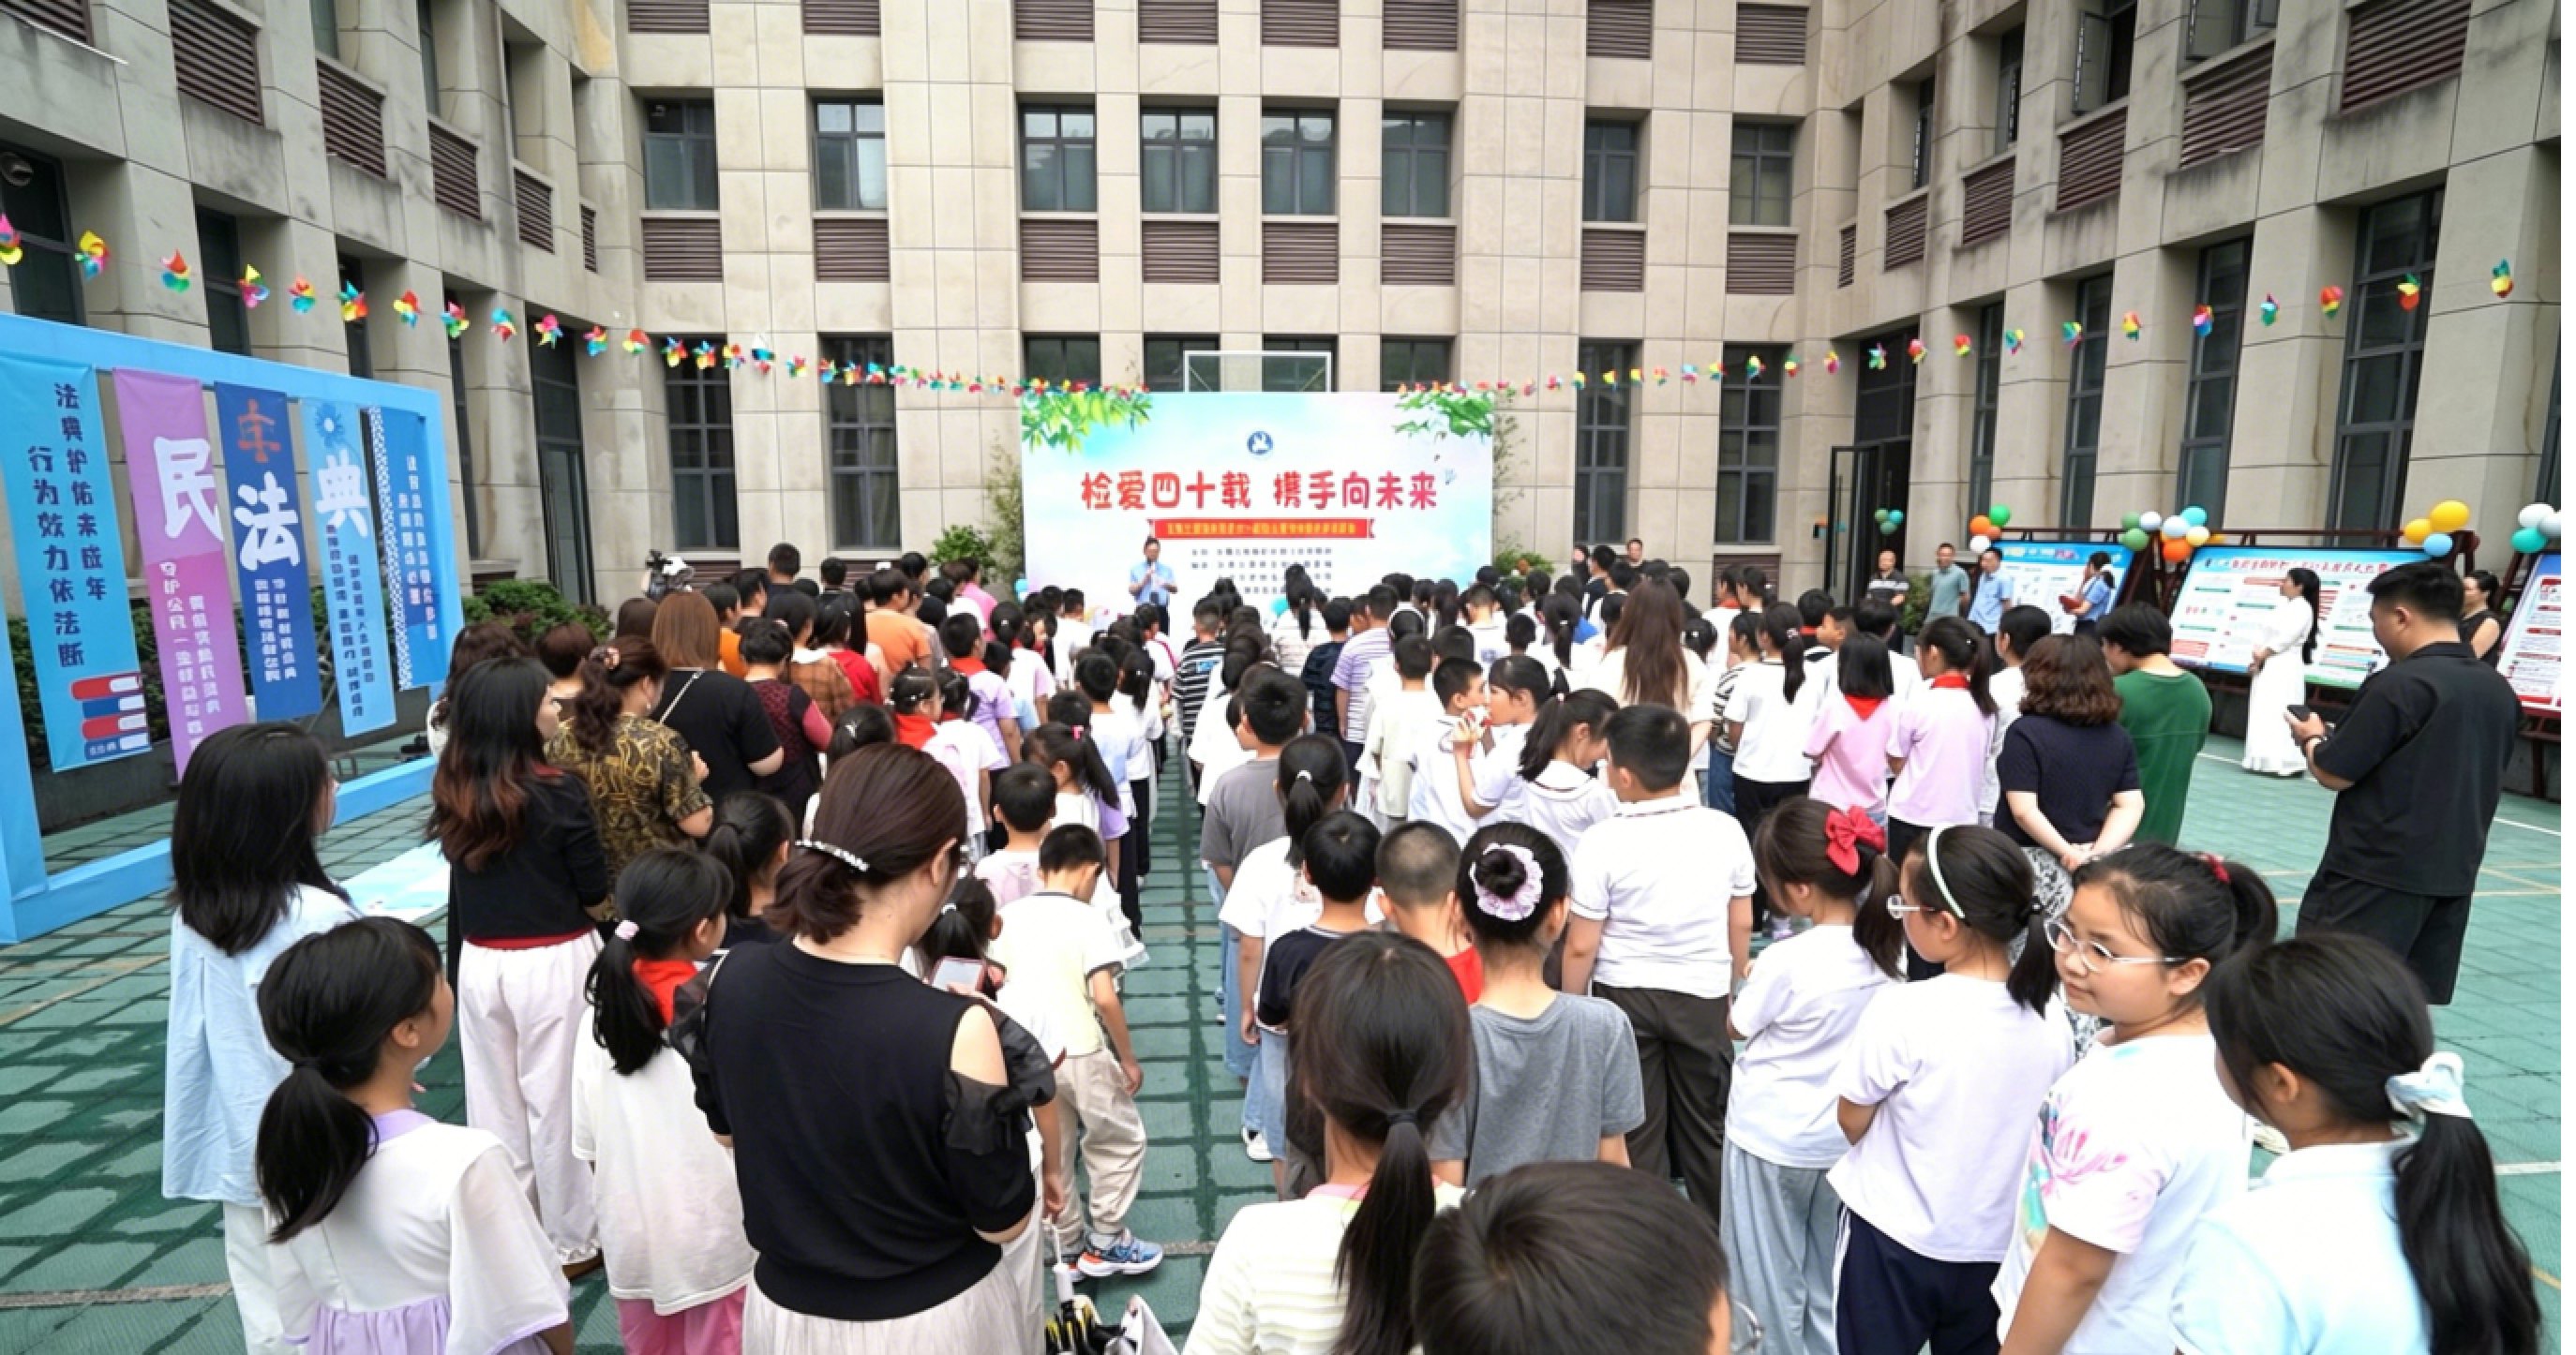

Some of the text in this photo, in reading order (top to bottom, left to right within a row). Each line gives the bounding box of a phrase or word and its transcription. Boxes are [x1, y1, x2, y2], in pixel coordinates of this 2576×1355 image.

[153, 437, 225, 542] 民
[233, 470, 299, 572] 法
[316, 452, 369, 538] 典
[1081, 469, 1438, 511] 检爱四十载 携手向未来
[27, 445, 85, 668] 行为效力依法断
